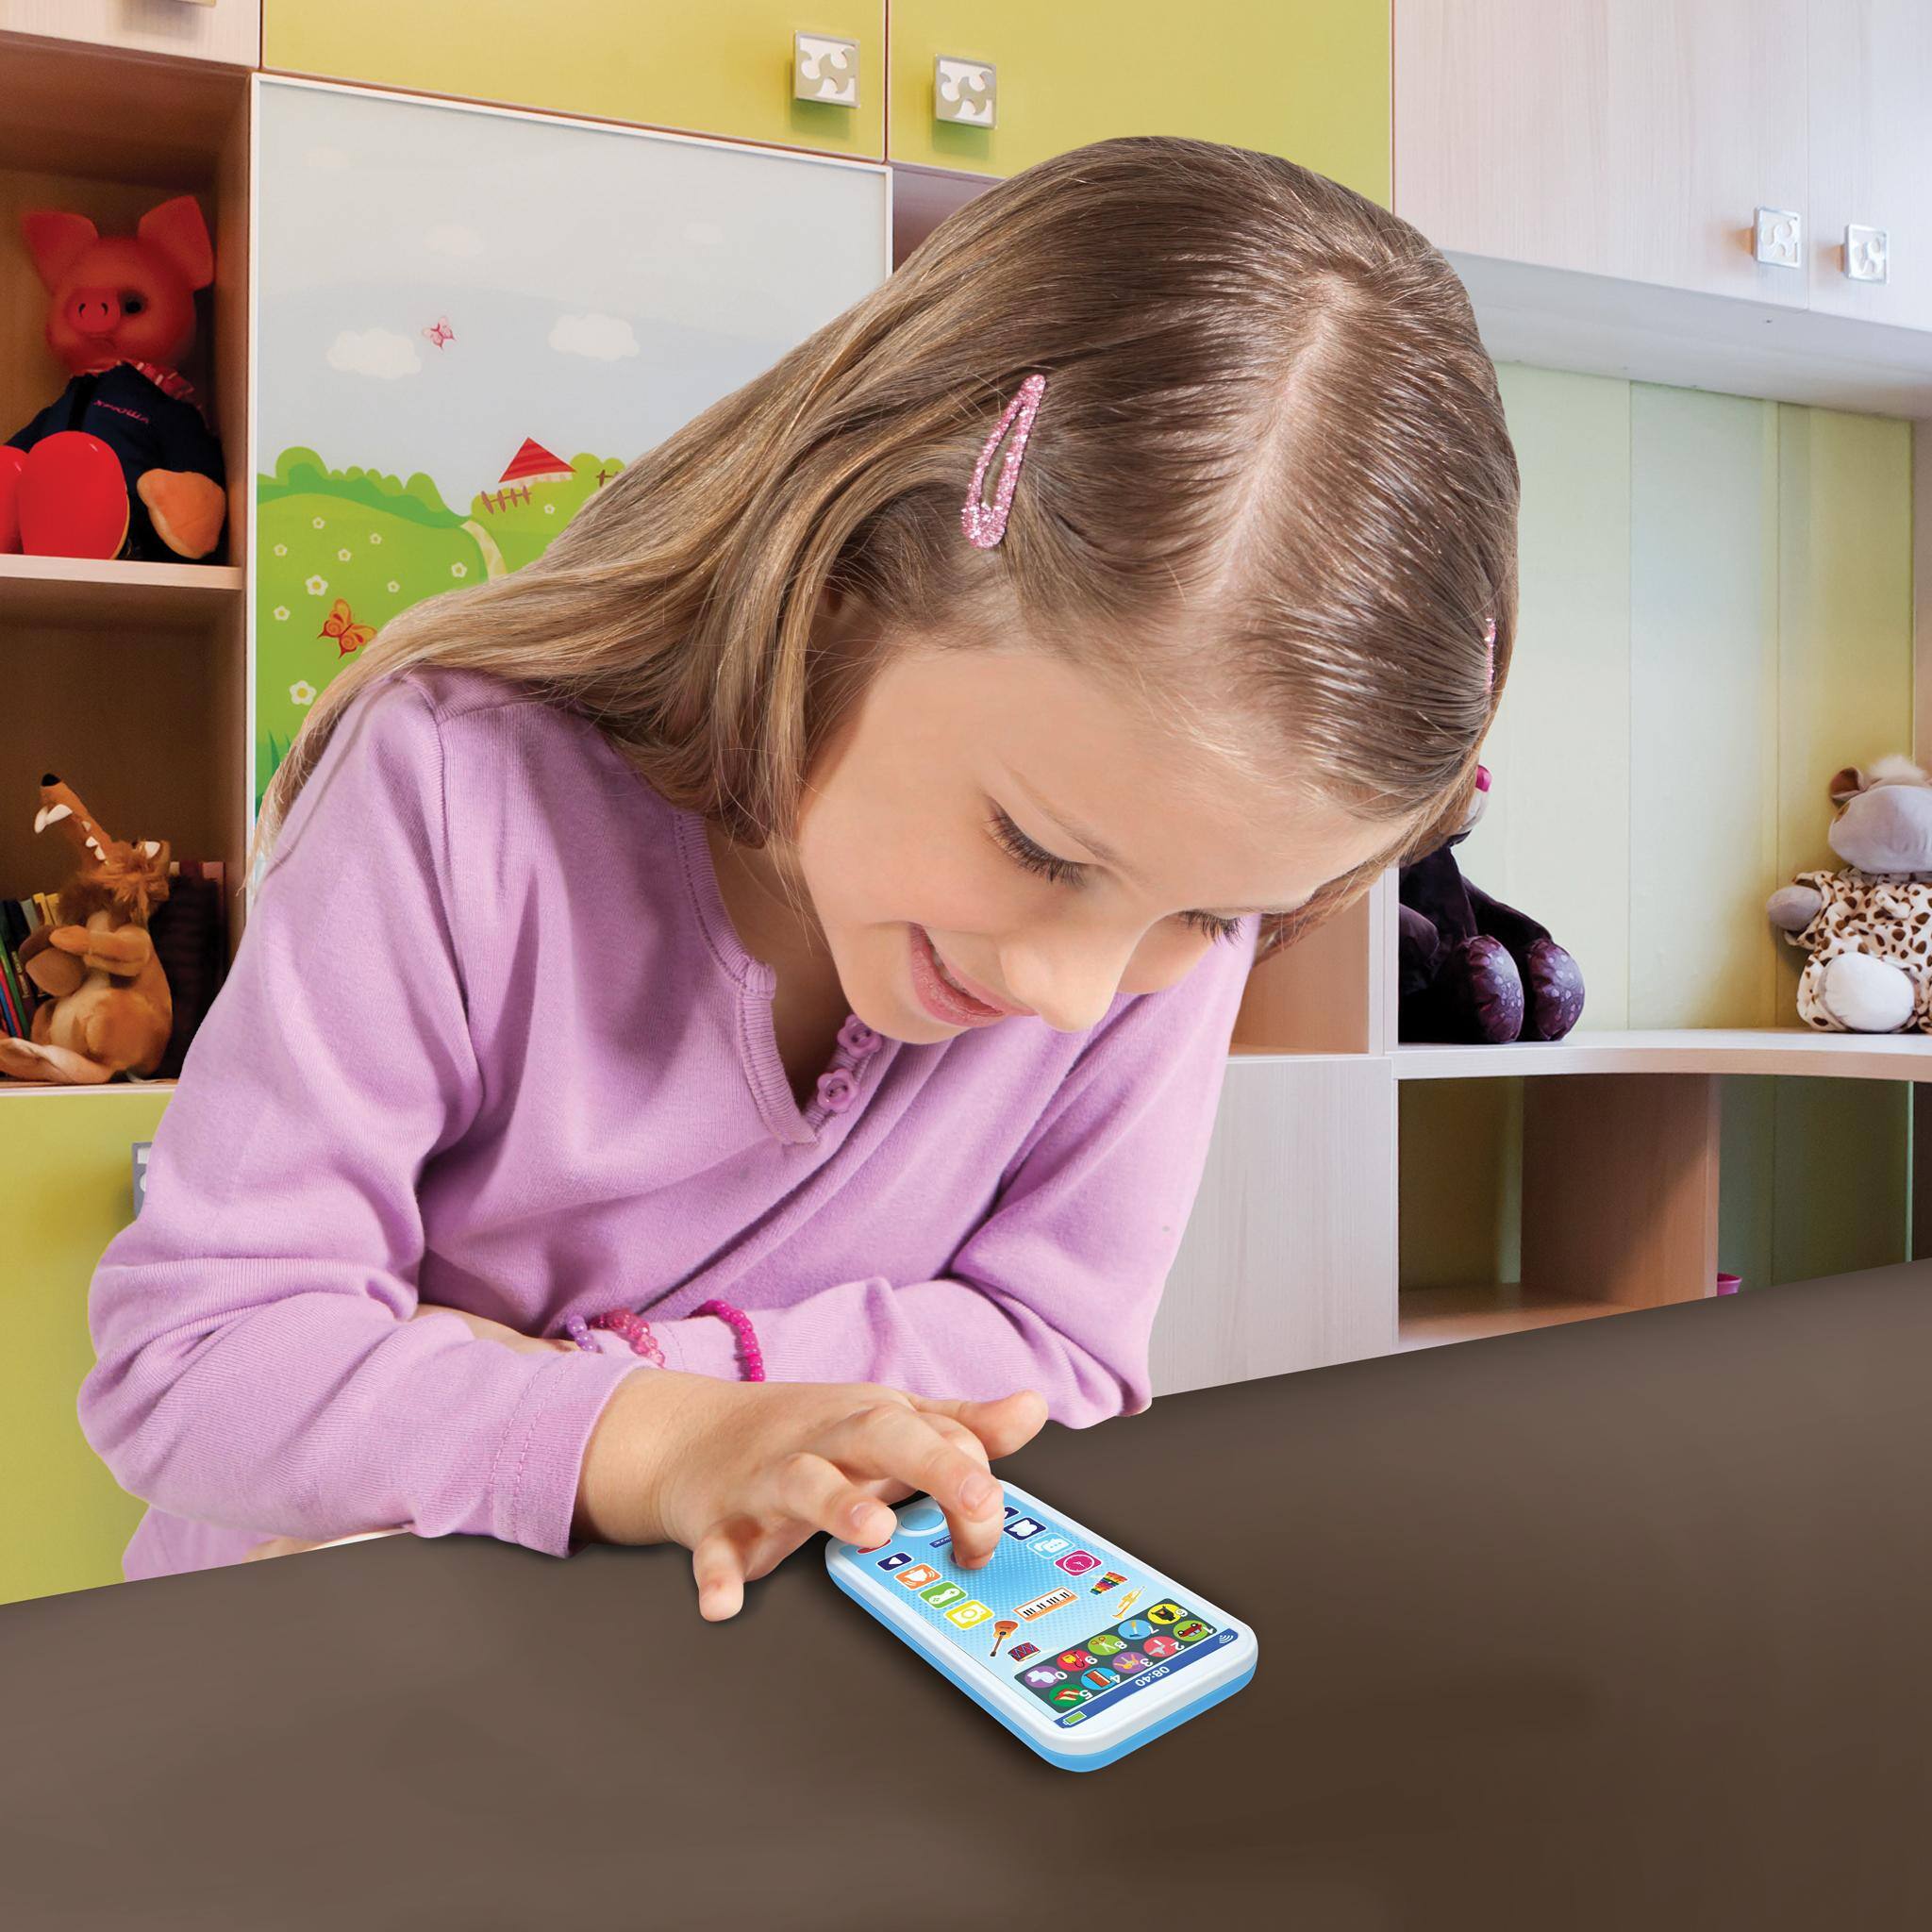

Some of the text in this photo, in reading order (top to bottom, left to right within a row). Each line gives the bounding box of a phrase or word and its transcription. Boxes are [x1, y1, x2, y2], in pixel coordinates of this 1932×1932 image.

[1055, 1607, 1189, 1680] 6 7 8 9 0
[1170, 1641, 1185, 1651] 2
[1140, 1657, 1153, 1668] 3
[1109, 1674, 1121, 1684] 4
[1135, 1666, 1170, 1687] 08:40
[1078, 1690, 1092, 1700] 5
